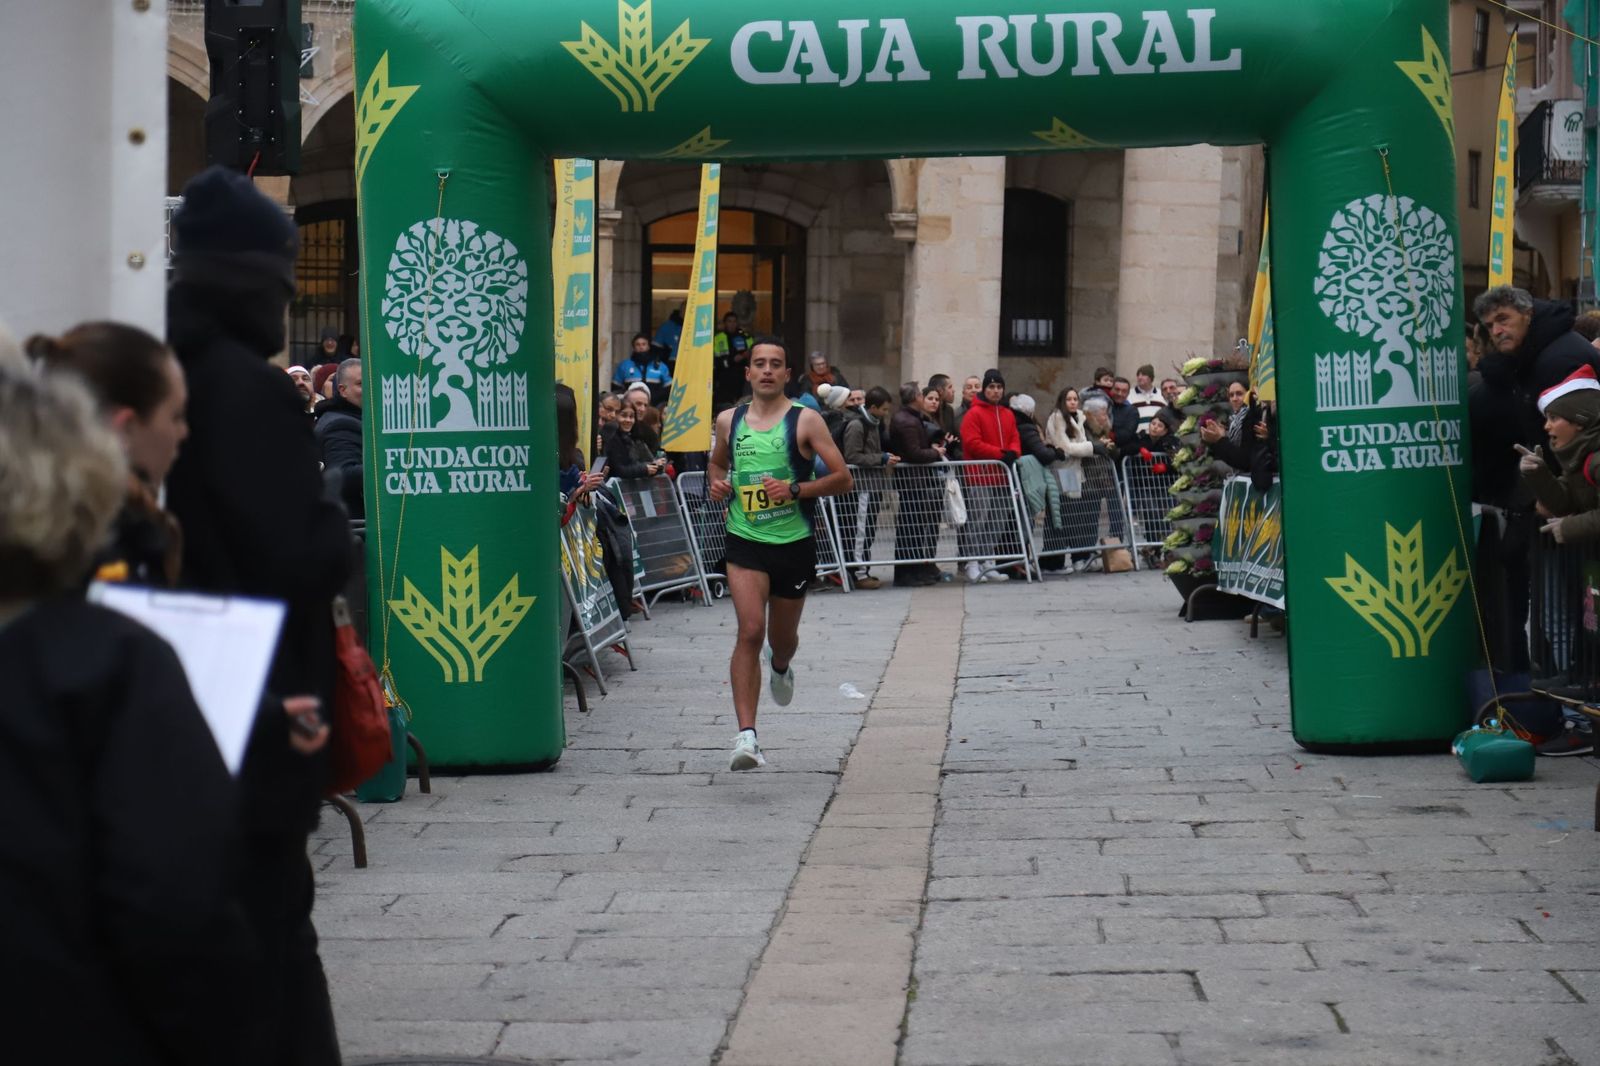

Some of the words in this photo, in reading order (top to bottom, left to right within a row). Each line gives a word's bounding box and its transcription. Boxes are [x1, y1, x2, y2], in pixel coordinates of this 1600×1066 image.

[730, 18, 931, 87] CAJA
[956, 8, 1242, 80] RURAL
[1320, 419, 1461, 448] FUNDACION
[385, 445, 530, 469] FUNDACION
[1321, 448, 1386, 472] CAJA
[1392, 443, 1464, 469] RURAL
[385, 472, 442, 496] CAJA
[448, 469, 532, 493] RURAL
